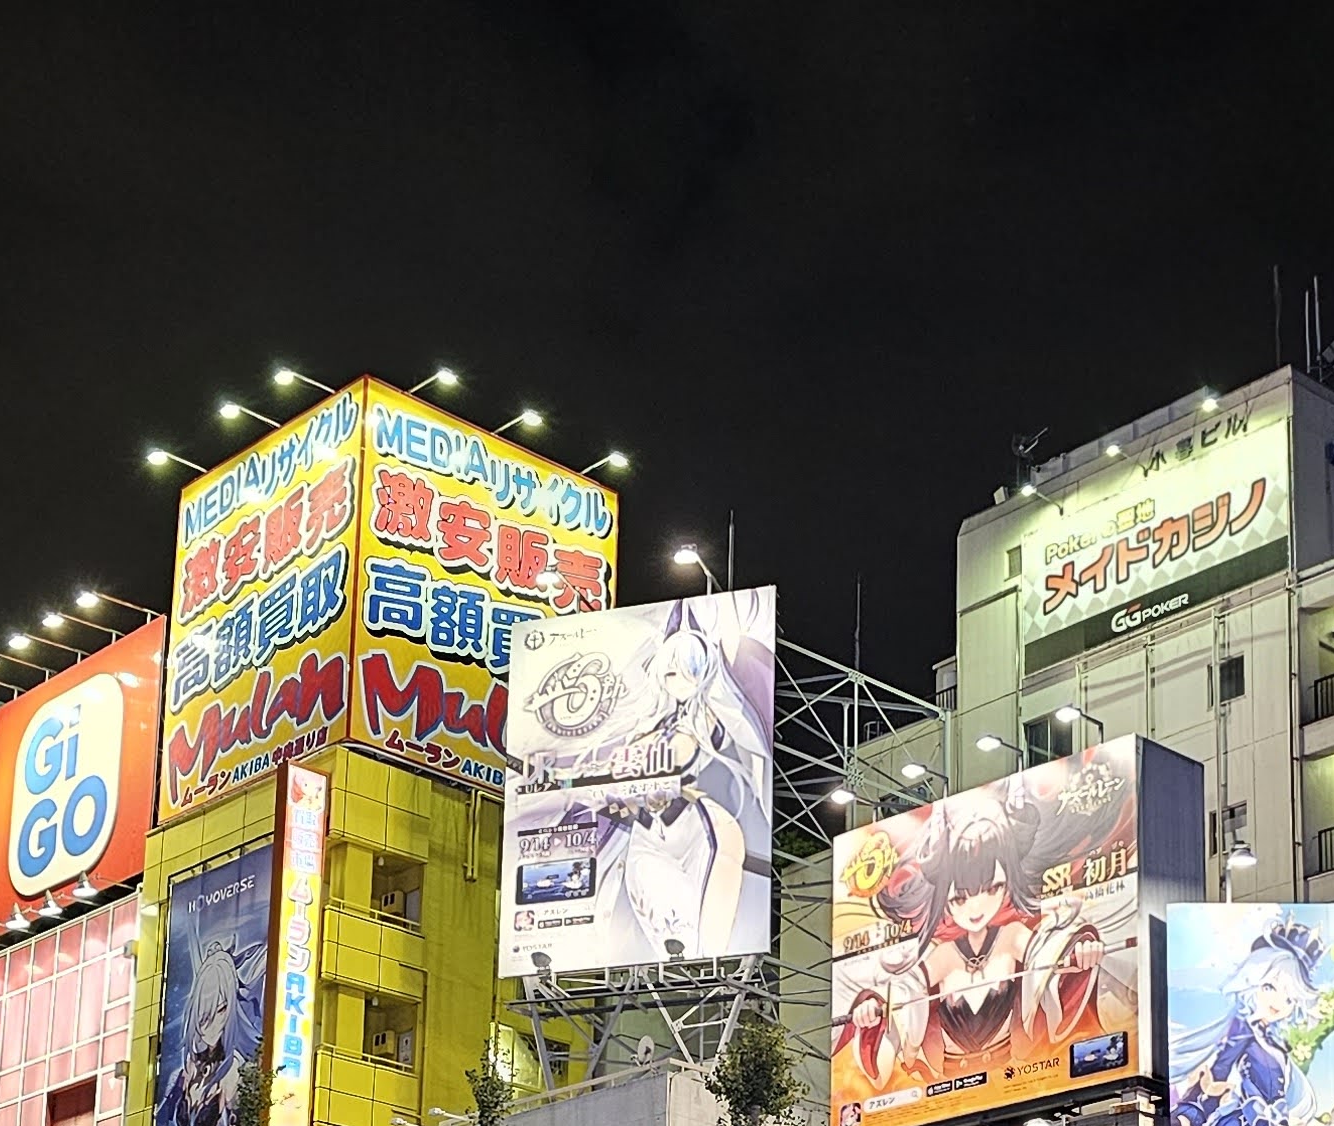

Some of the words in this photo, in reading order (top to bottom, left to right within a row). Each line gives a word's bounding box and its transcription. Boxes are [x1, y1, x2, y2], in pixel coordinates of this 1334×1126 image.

[183, 391, 360, 545] MEDIAリサイクル
[371, 407, 612, 538] MEDIAリサイクル
[178, 457, 354, 622] 激安販売
[369, 467, 605, 614] 激安販売
[1043, 478, 1267, 616] メイドカジノ
[171, 547, 348, 713] 高額買取
[364, 558, 546, 678] 高額買
[167, 653, 347, 805] Mulan
[360, 653, 509, 751] Mul
[181, 770, 232, 807] ムーラン
[232, 752, 271, 784] AKIBA
[386, 730, 462, 769] ムーラン
[461, 761, 507, 787] AKIB
[519, 834, 551, 851] 9/14
[565, 831, 597, 849] 10/4
[1041, 862, 1073, 893] SSR
[1083, 848, 1128, 886] 初月
[883, 919, 914, 941] 10/4
[278, 972, 305, 1079] AKIBA
[1017, 1057, 1060, 1076] YOSTAR
[869, 1097, 896, 1110] アズレン
